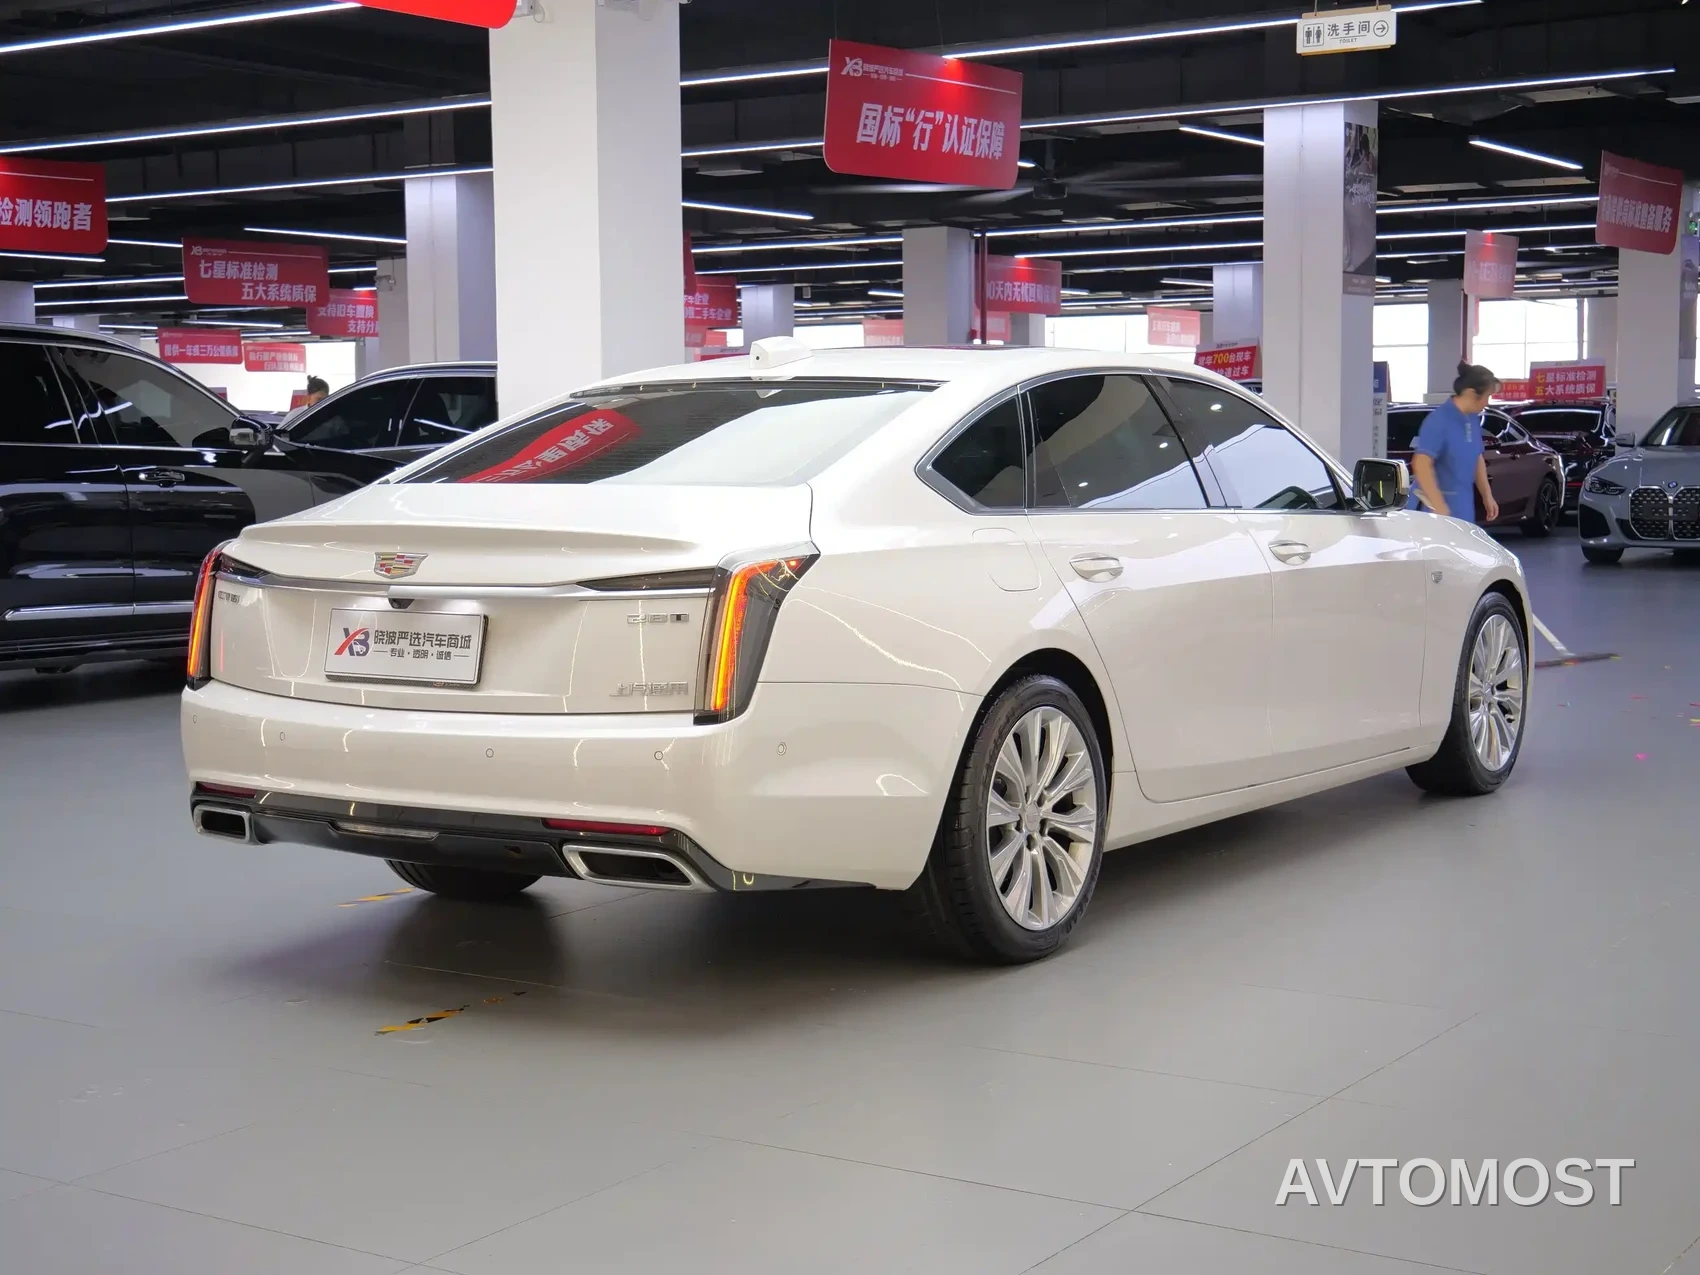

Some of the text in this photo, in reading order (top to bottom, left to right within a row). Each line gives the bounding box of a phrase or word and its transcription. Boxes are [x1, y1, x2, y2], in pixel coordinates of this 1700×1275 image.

[1327, 20, 1371, 37] 洗手间
[199, 259, 279, 281] 七星标准检测
[241, 282, 317, 303] 五大系统质保
[1535, 370, 1597, 384] 七星标准检测
[1534, 383, 1596, 396] 五大系统质保
[373, 629, 472, 650] 晓波严选汽车商城
